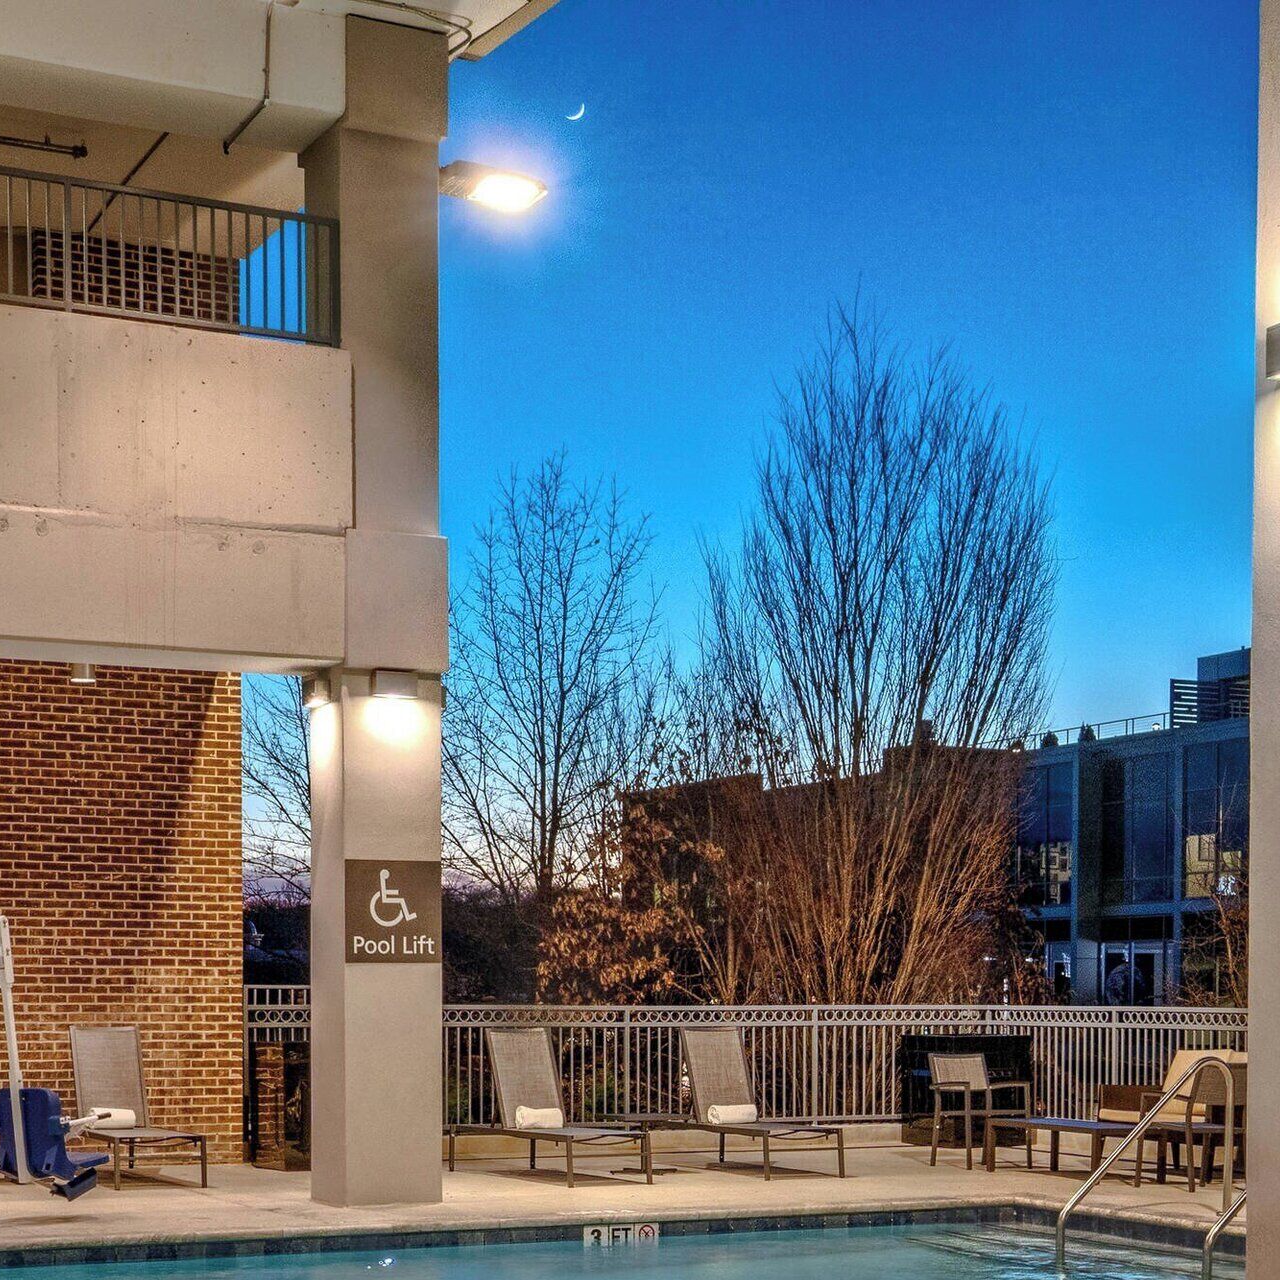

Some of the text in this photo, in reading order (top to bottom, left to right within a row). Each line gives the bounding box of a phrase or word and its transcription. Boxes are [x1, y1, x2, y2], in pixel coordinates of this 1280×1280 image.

[353, 935, 435, 955] Pool Lift
[612, 1227, 632, 1240] FT
